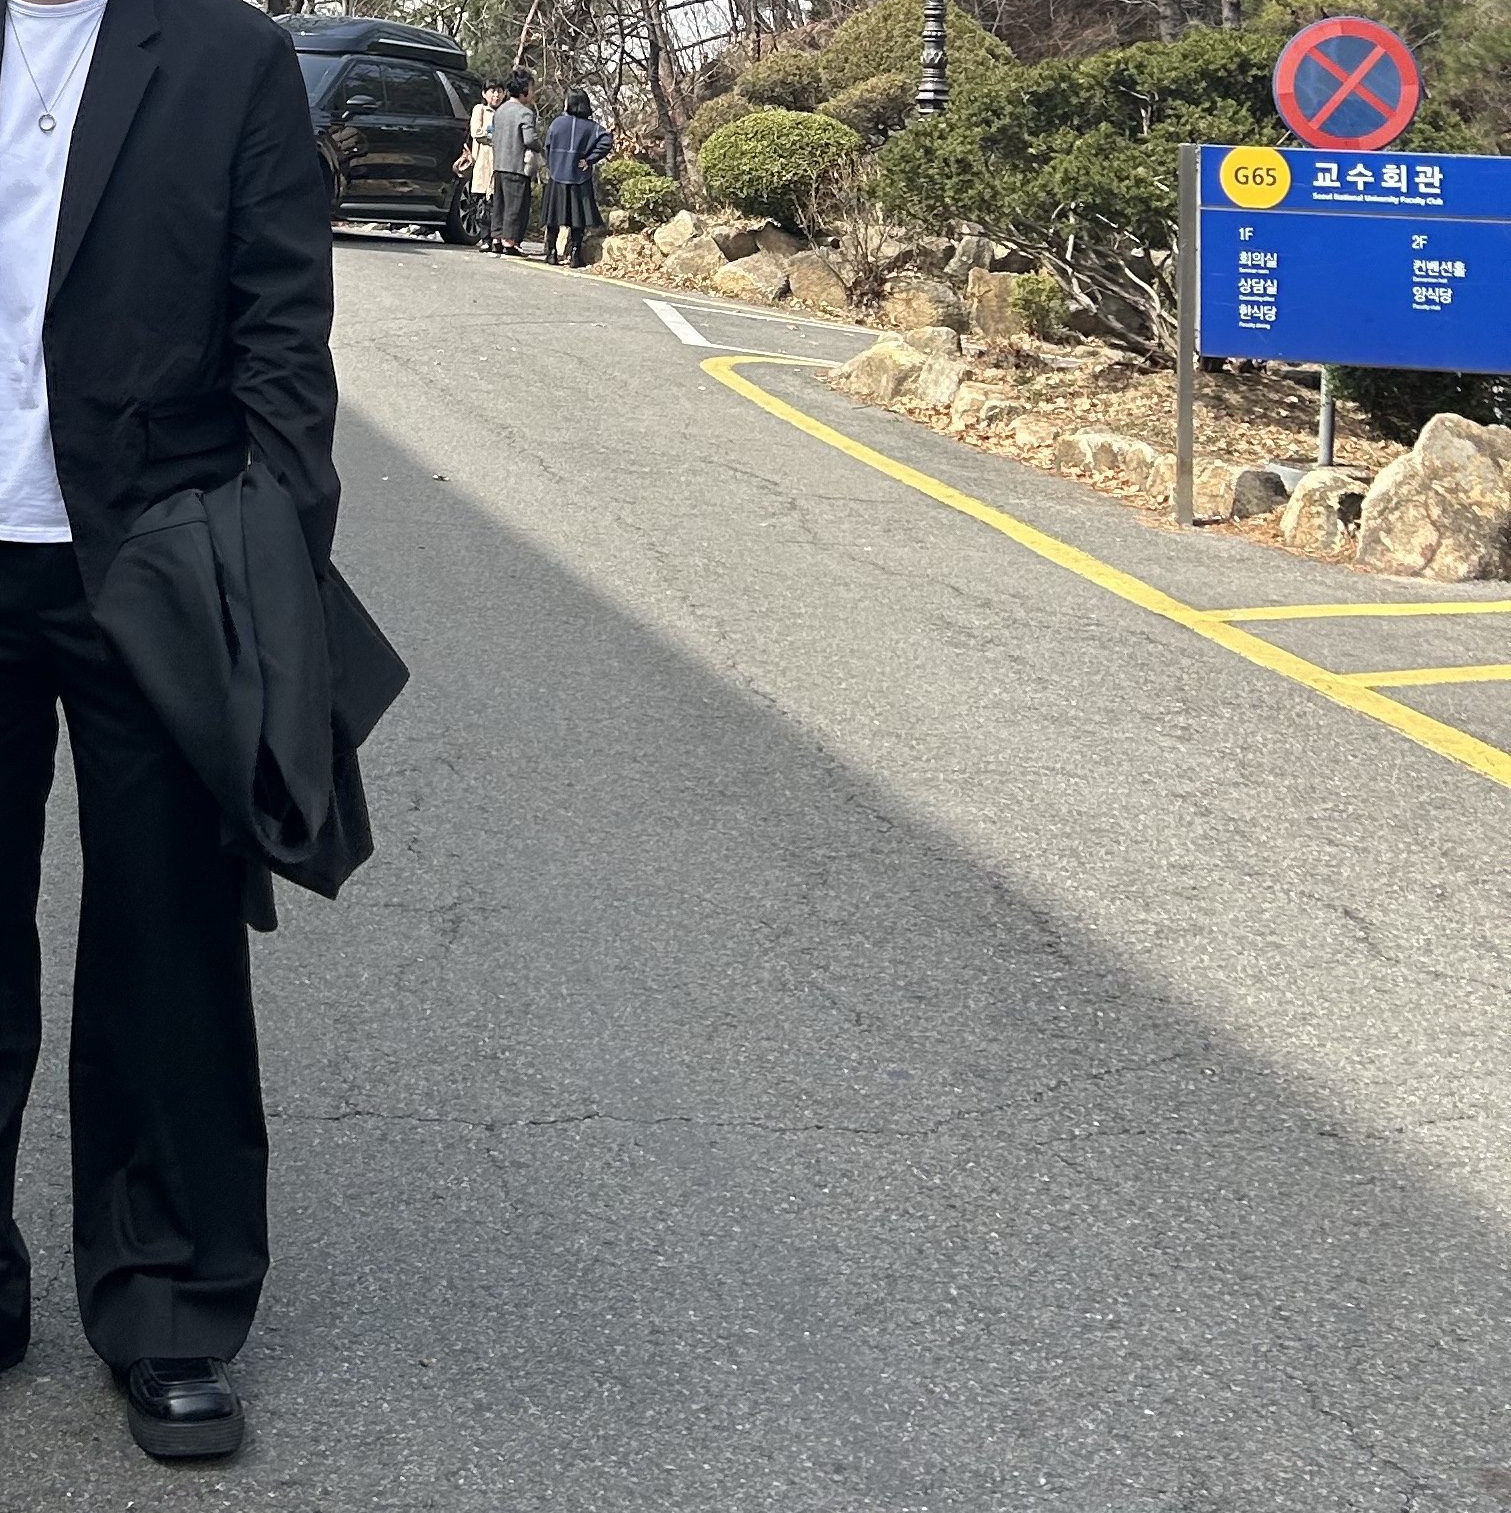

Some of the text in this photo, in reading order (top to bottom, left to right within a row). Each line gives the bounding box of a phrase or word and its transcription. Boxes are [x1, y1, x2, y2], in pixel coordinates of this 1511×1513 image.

[1234, 166, 1277, 187] G65
[1312, 162, 1444, 194] 교수회관
[1312, 192, 1333, 200] Seoul
[1364, 194, 1400, 205] University
[1399, 196, 1426, 206] Faculty
[1238, 227, 1254, 241] 1F
[1411, 234, 1428, 249] 2F
[1238, 251, 1278, 268] 회의실
[1412, 259, 1467, 278] 컨벤션홀
[1238, 277, 1278, 295] 상담실
[1412, 286, 1453, 304] 양식당
[1238, 303, 1278, 321] 한식당
